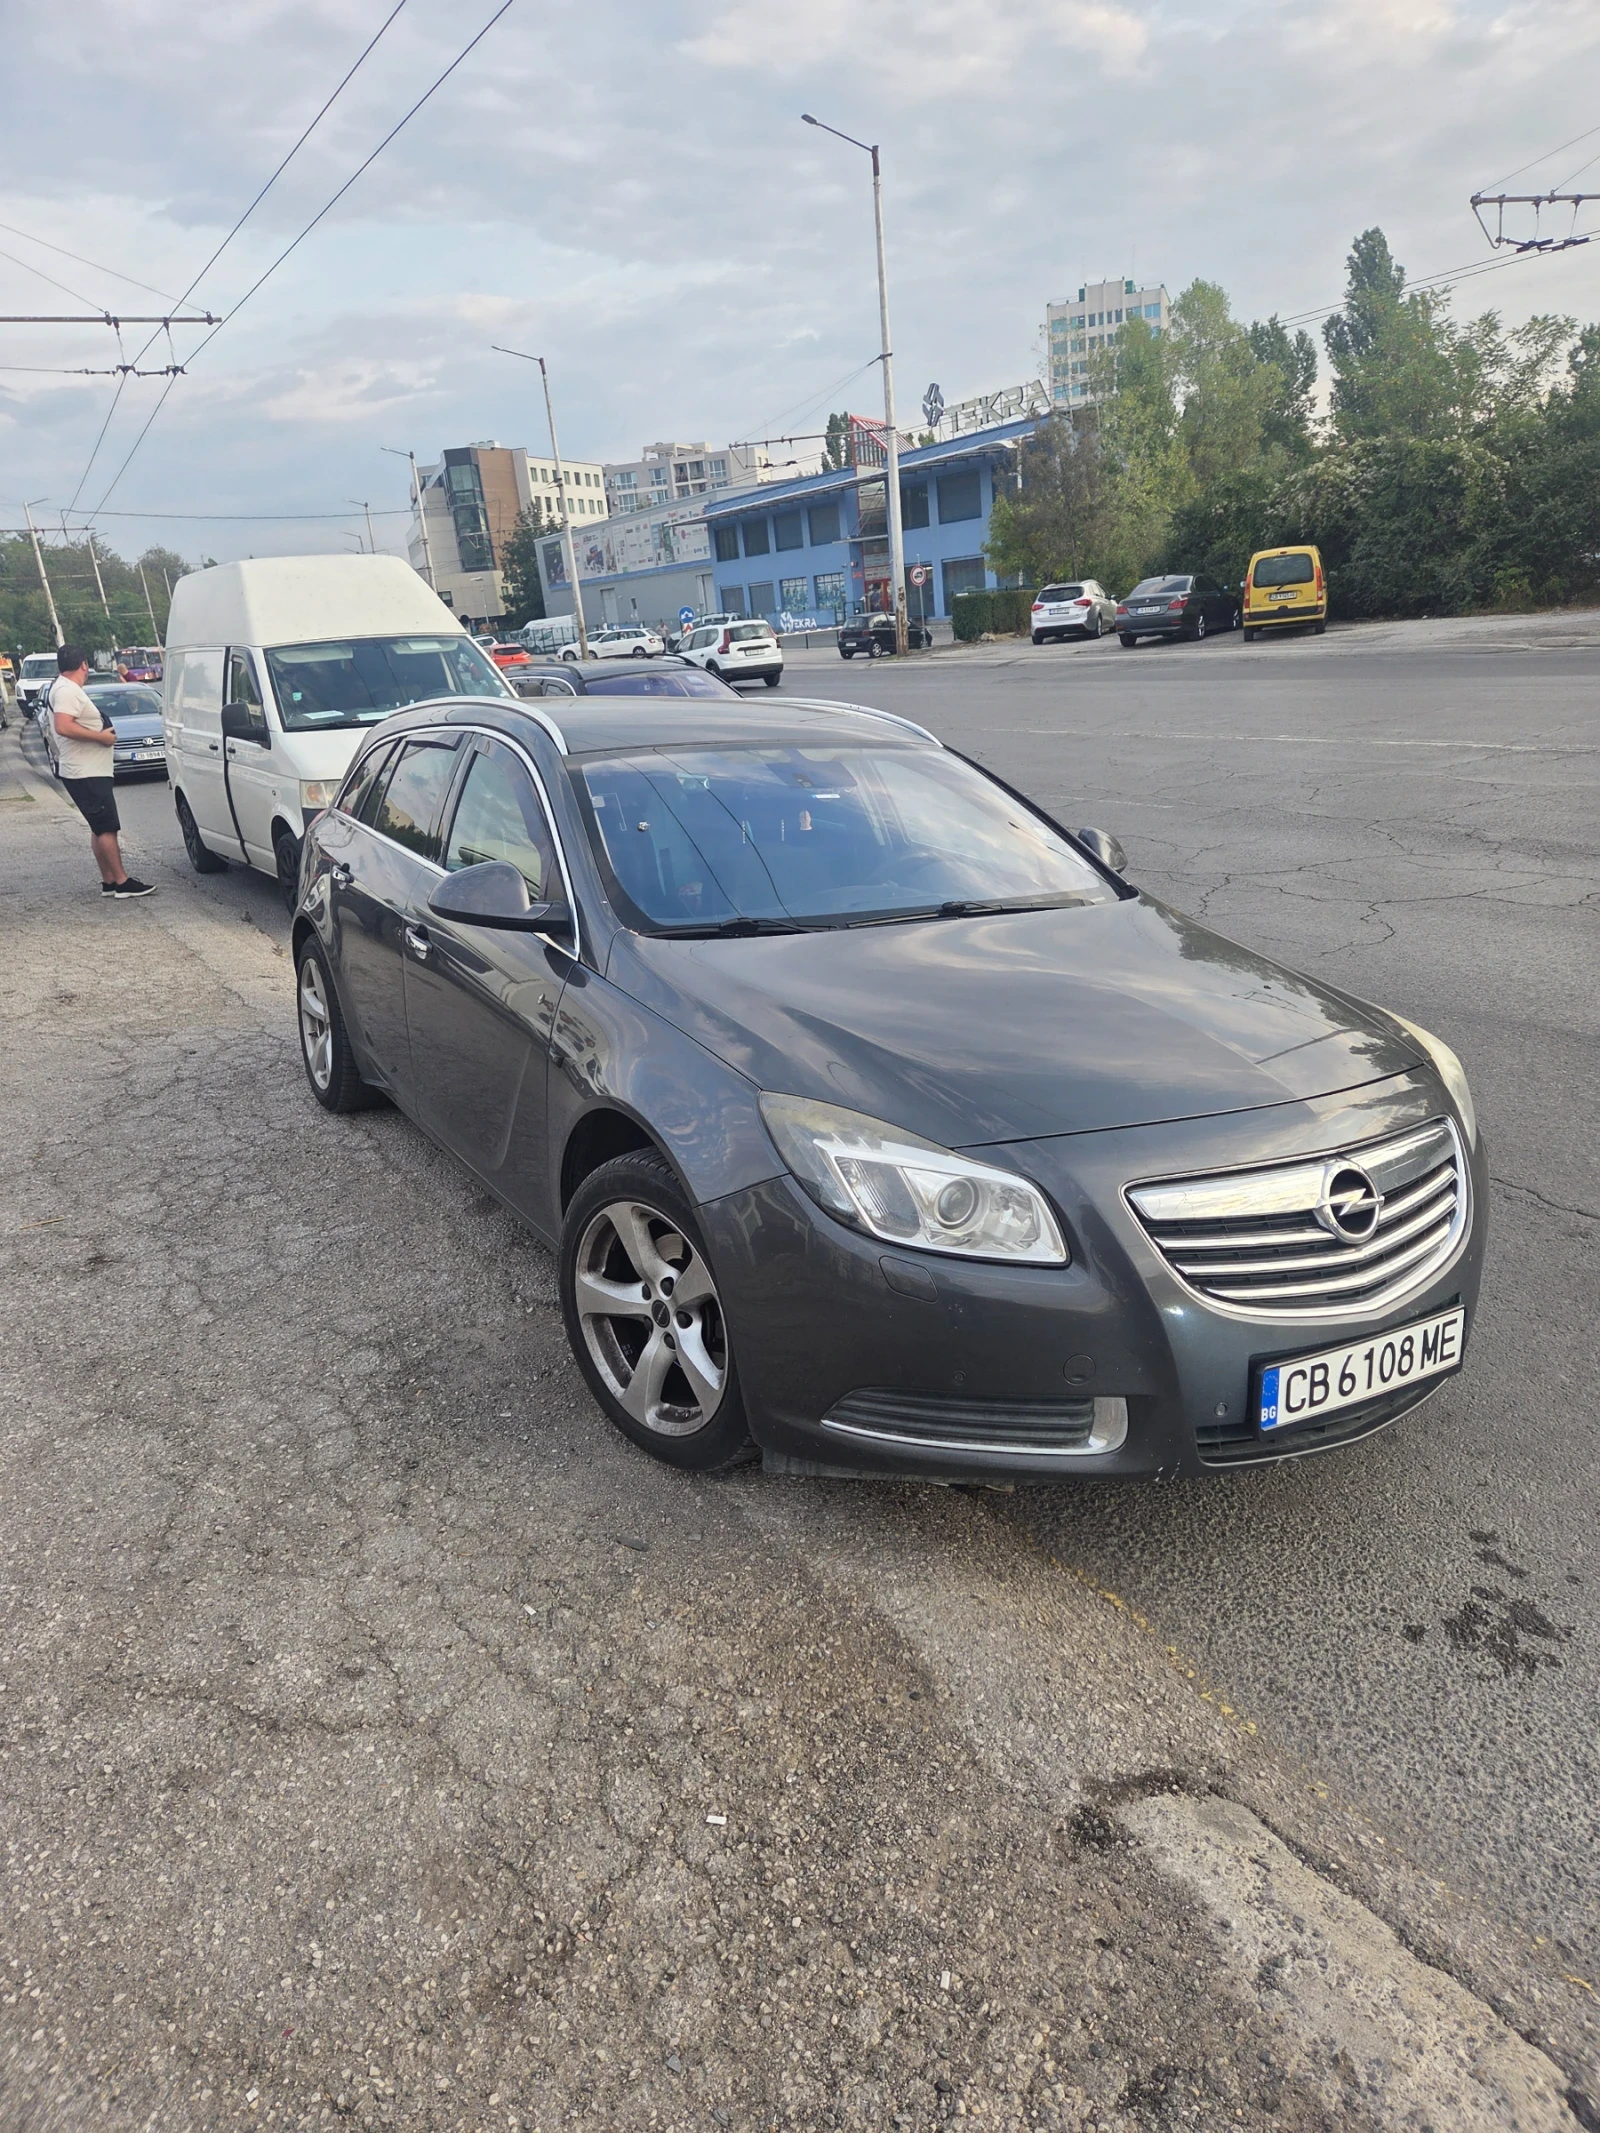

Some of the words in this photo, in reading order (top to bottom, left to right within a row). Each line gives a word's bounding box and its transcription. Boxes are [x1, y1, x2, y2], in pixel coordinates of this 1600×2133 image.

[943, 379, 1051, 433] TEKRA
[790, 617, 817, 630] TEKRA
[1285, 1362, 1330, 1413] CB
[1338, 1335, 1415, 1397] 6108
[1420, 1318, 1458, 1370] ME
[1261, 1405, 1277, 1422] BG
